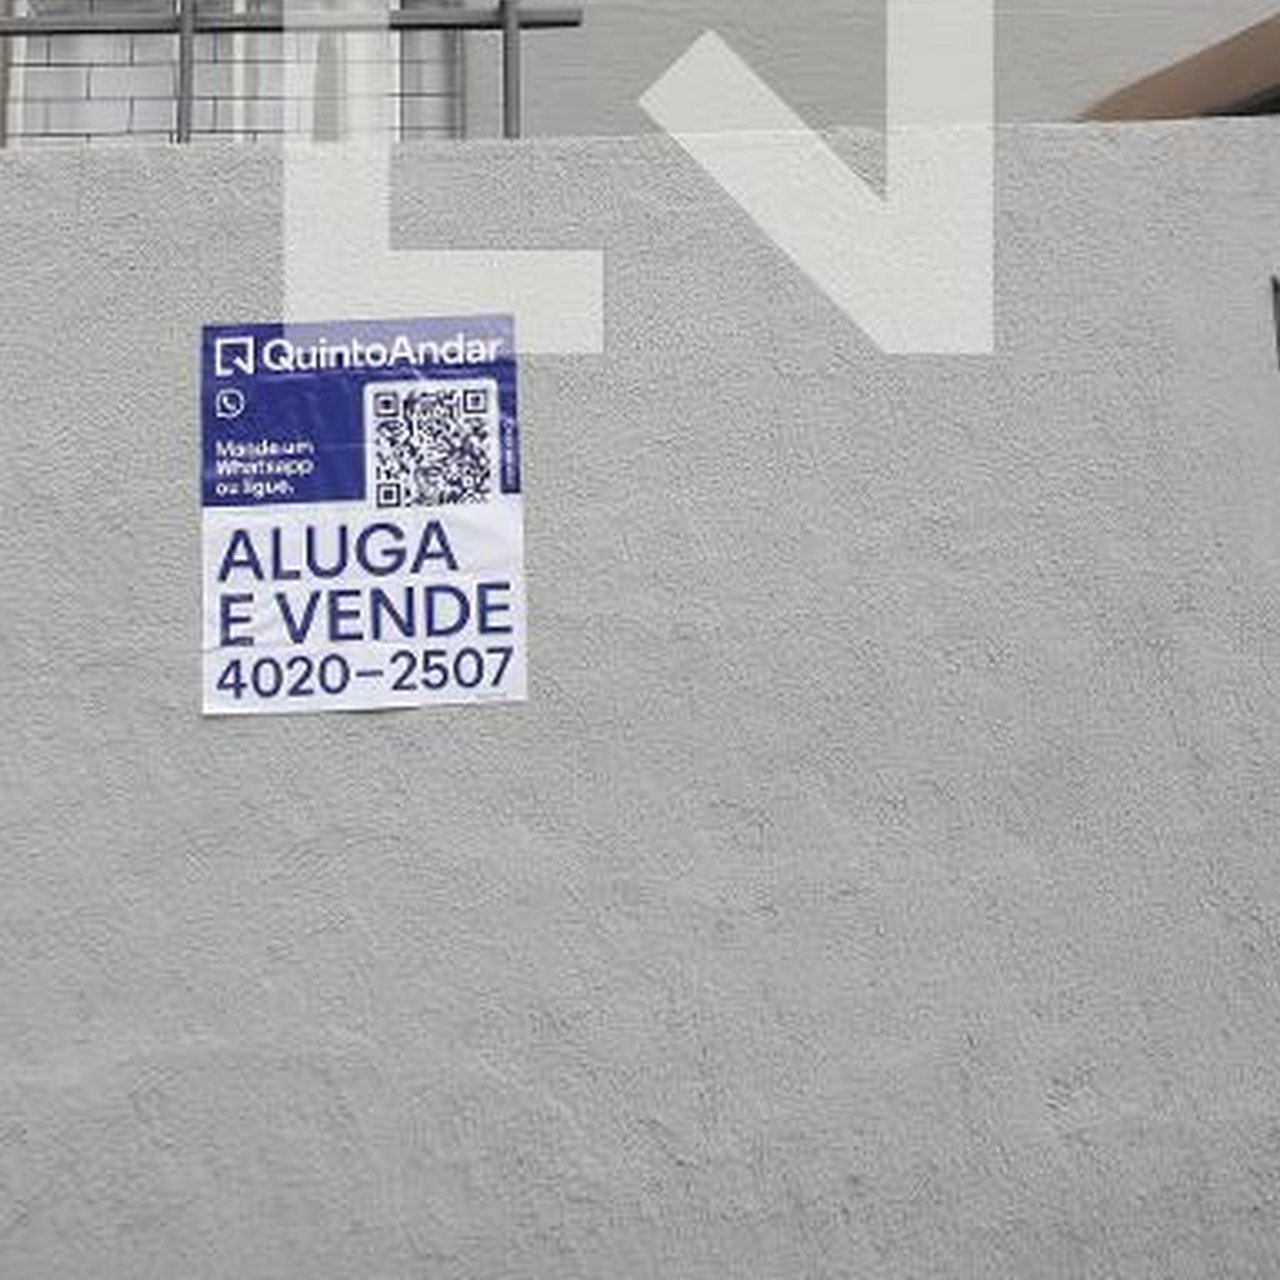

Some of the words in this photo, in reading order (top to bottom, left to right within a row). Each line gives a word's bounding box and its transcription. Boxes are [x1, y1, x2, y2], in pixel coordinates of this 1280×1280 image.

[263, 334, 502, 371] QuintoAndar
[217, 521, 458, 581] ALUGA
[221, 593, 255, 646] E
[275, 581, 513, 644] VENDE
[216, 646, 513, 699] 4020-2507
